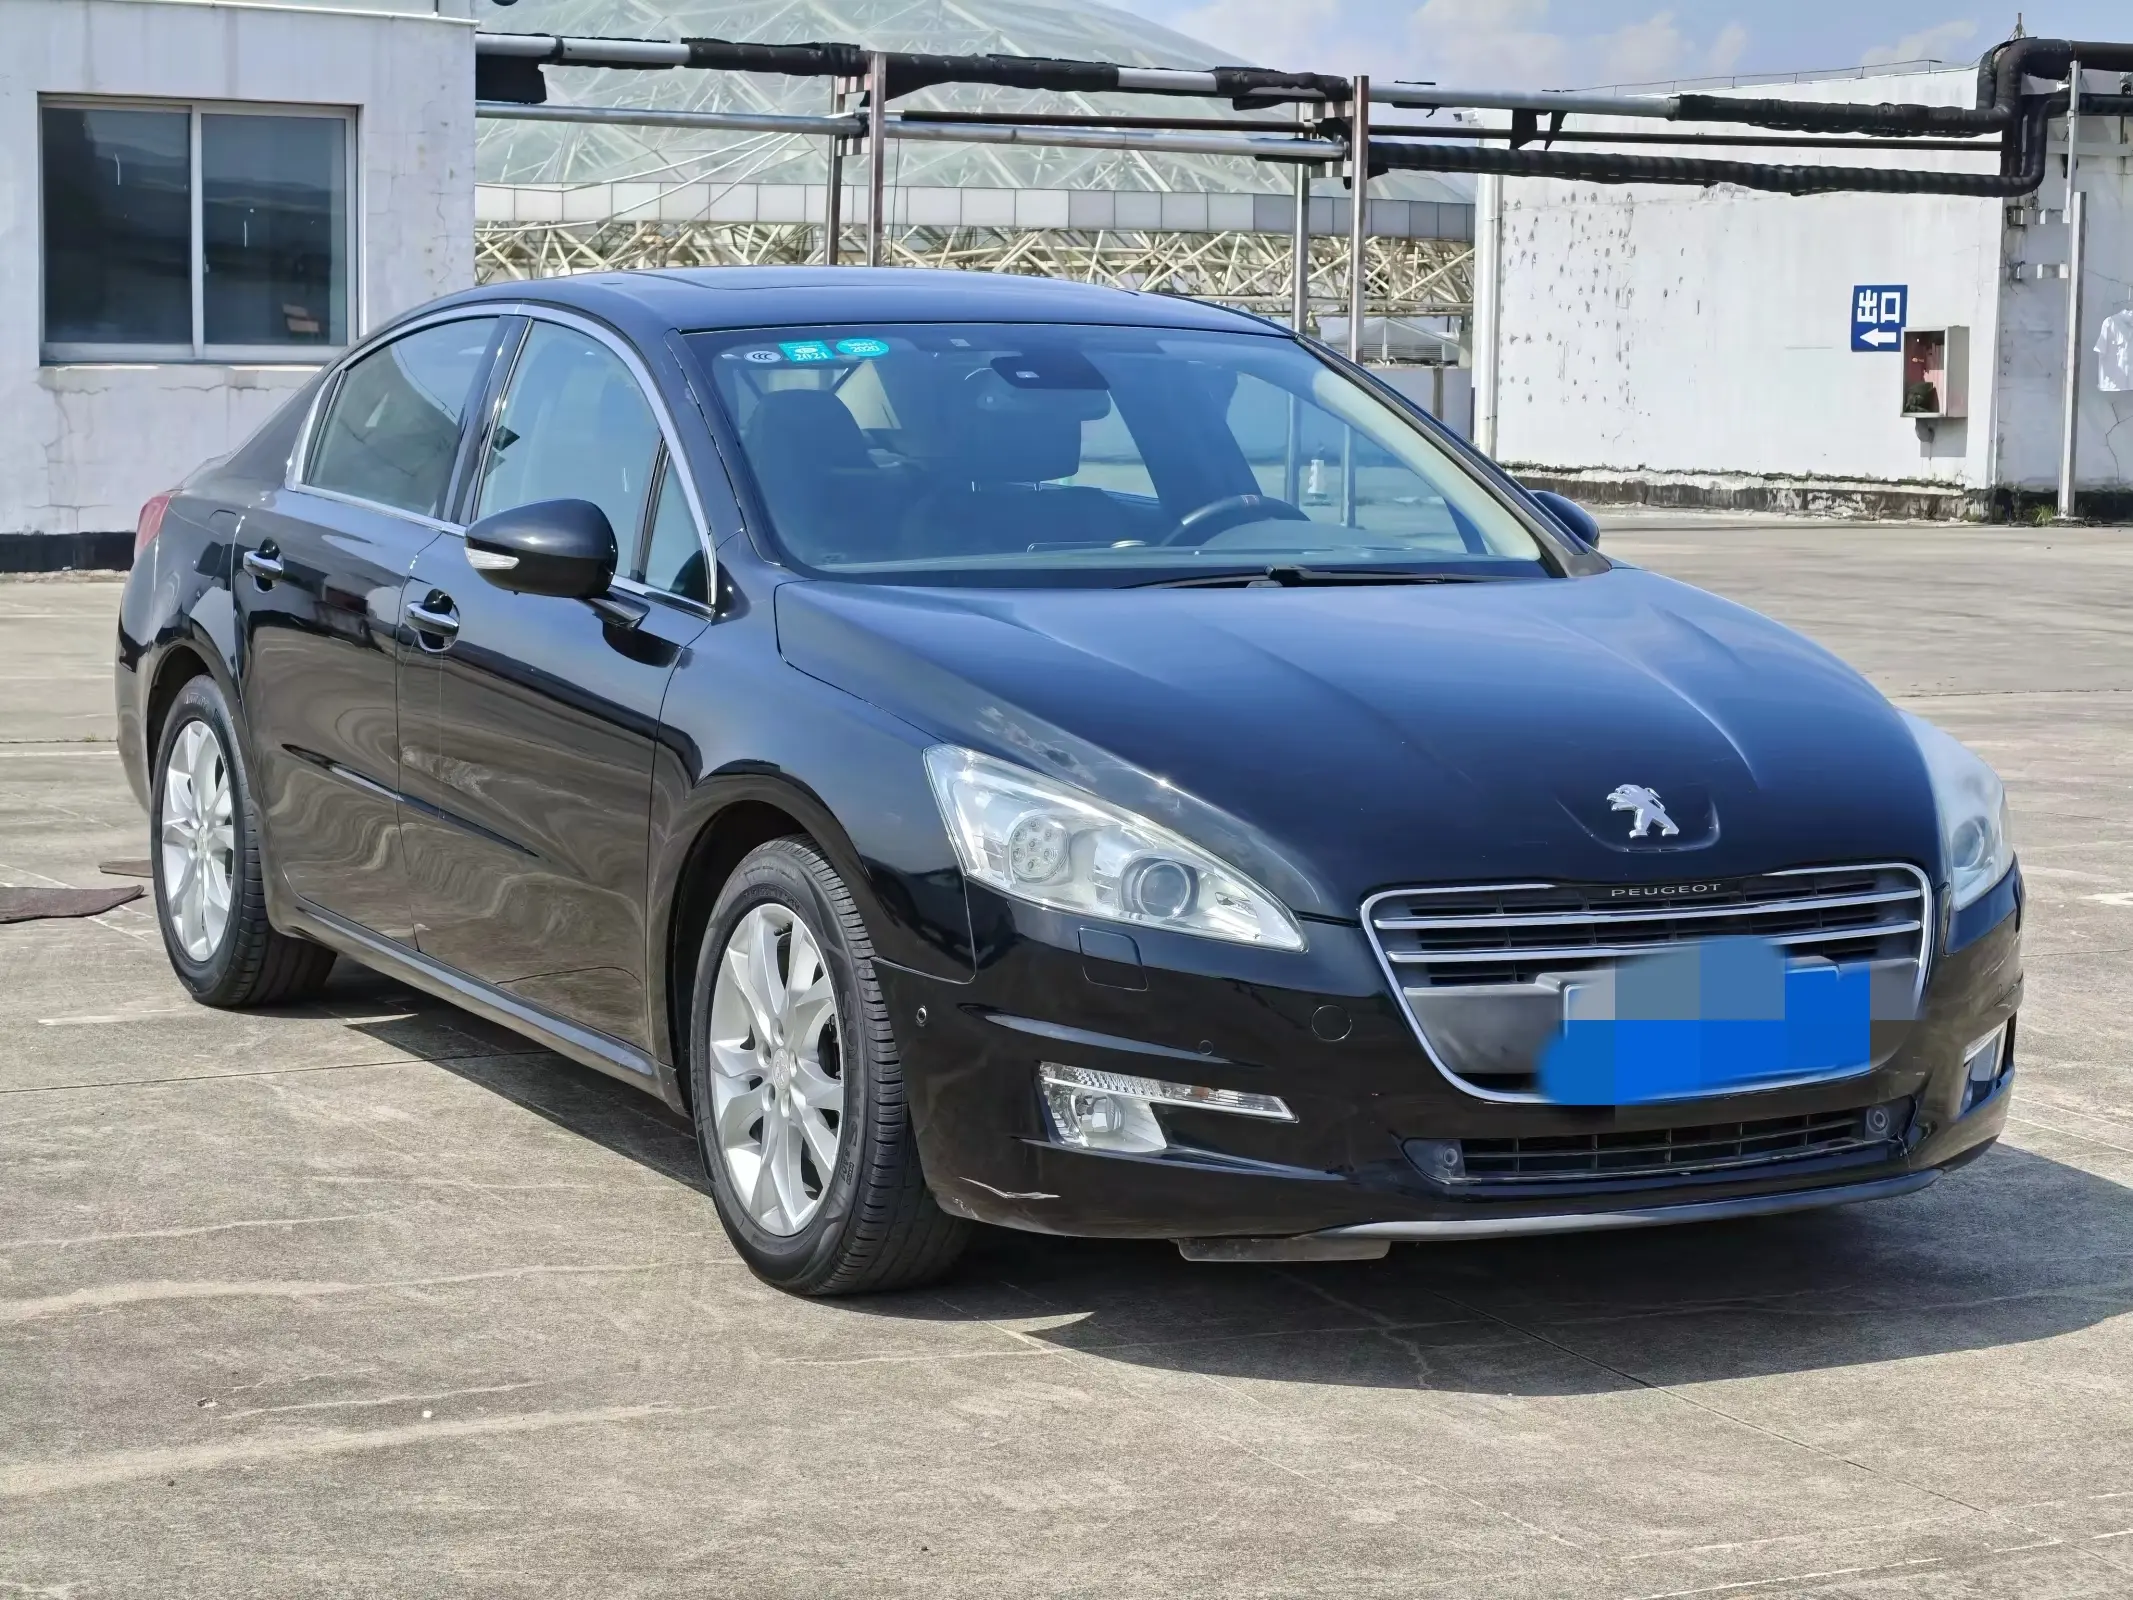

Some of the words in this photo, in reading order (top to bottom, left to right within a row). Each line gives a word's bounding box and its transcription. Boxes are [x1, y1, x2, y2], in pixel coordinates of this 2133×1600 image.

[1857, 289, 1901, 323] 出口
[850, 345, 880, 353] 2020
[794, 352, 829, 361] 2021
[1611, 883, 1722, 897] PEUGEOT
